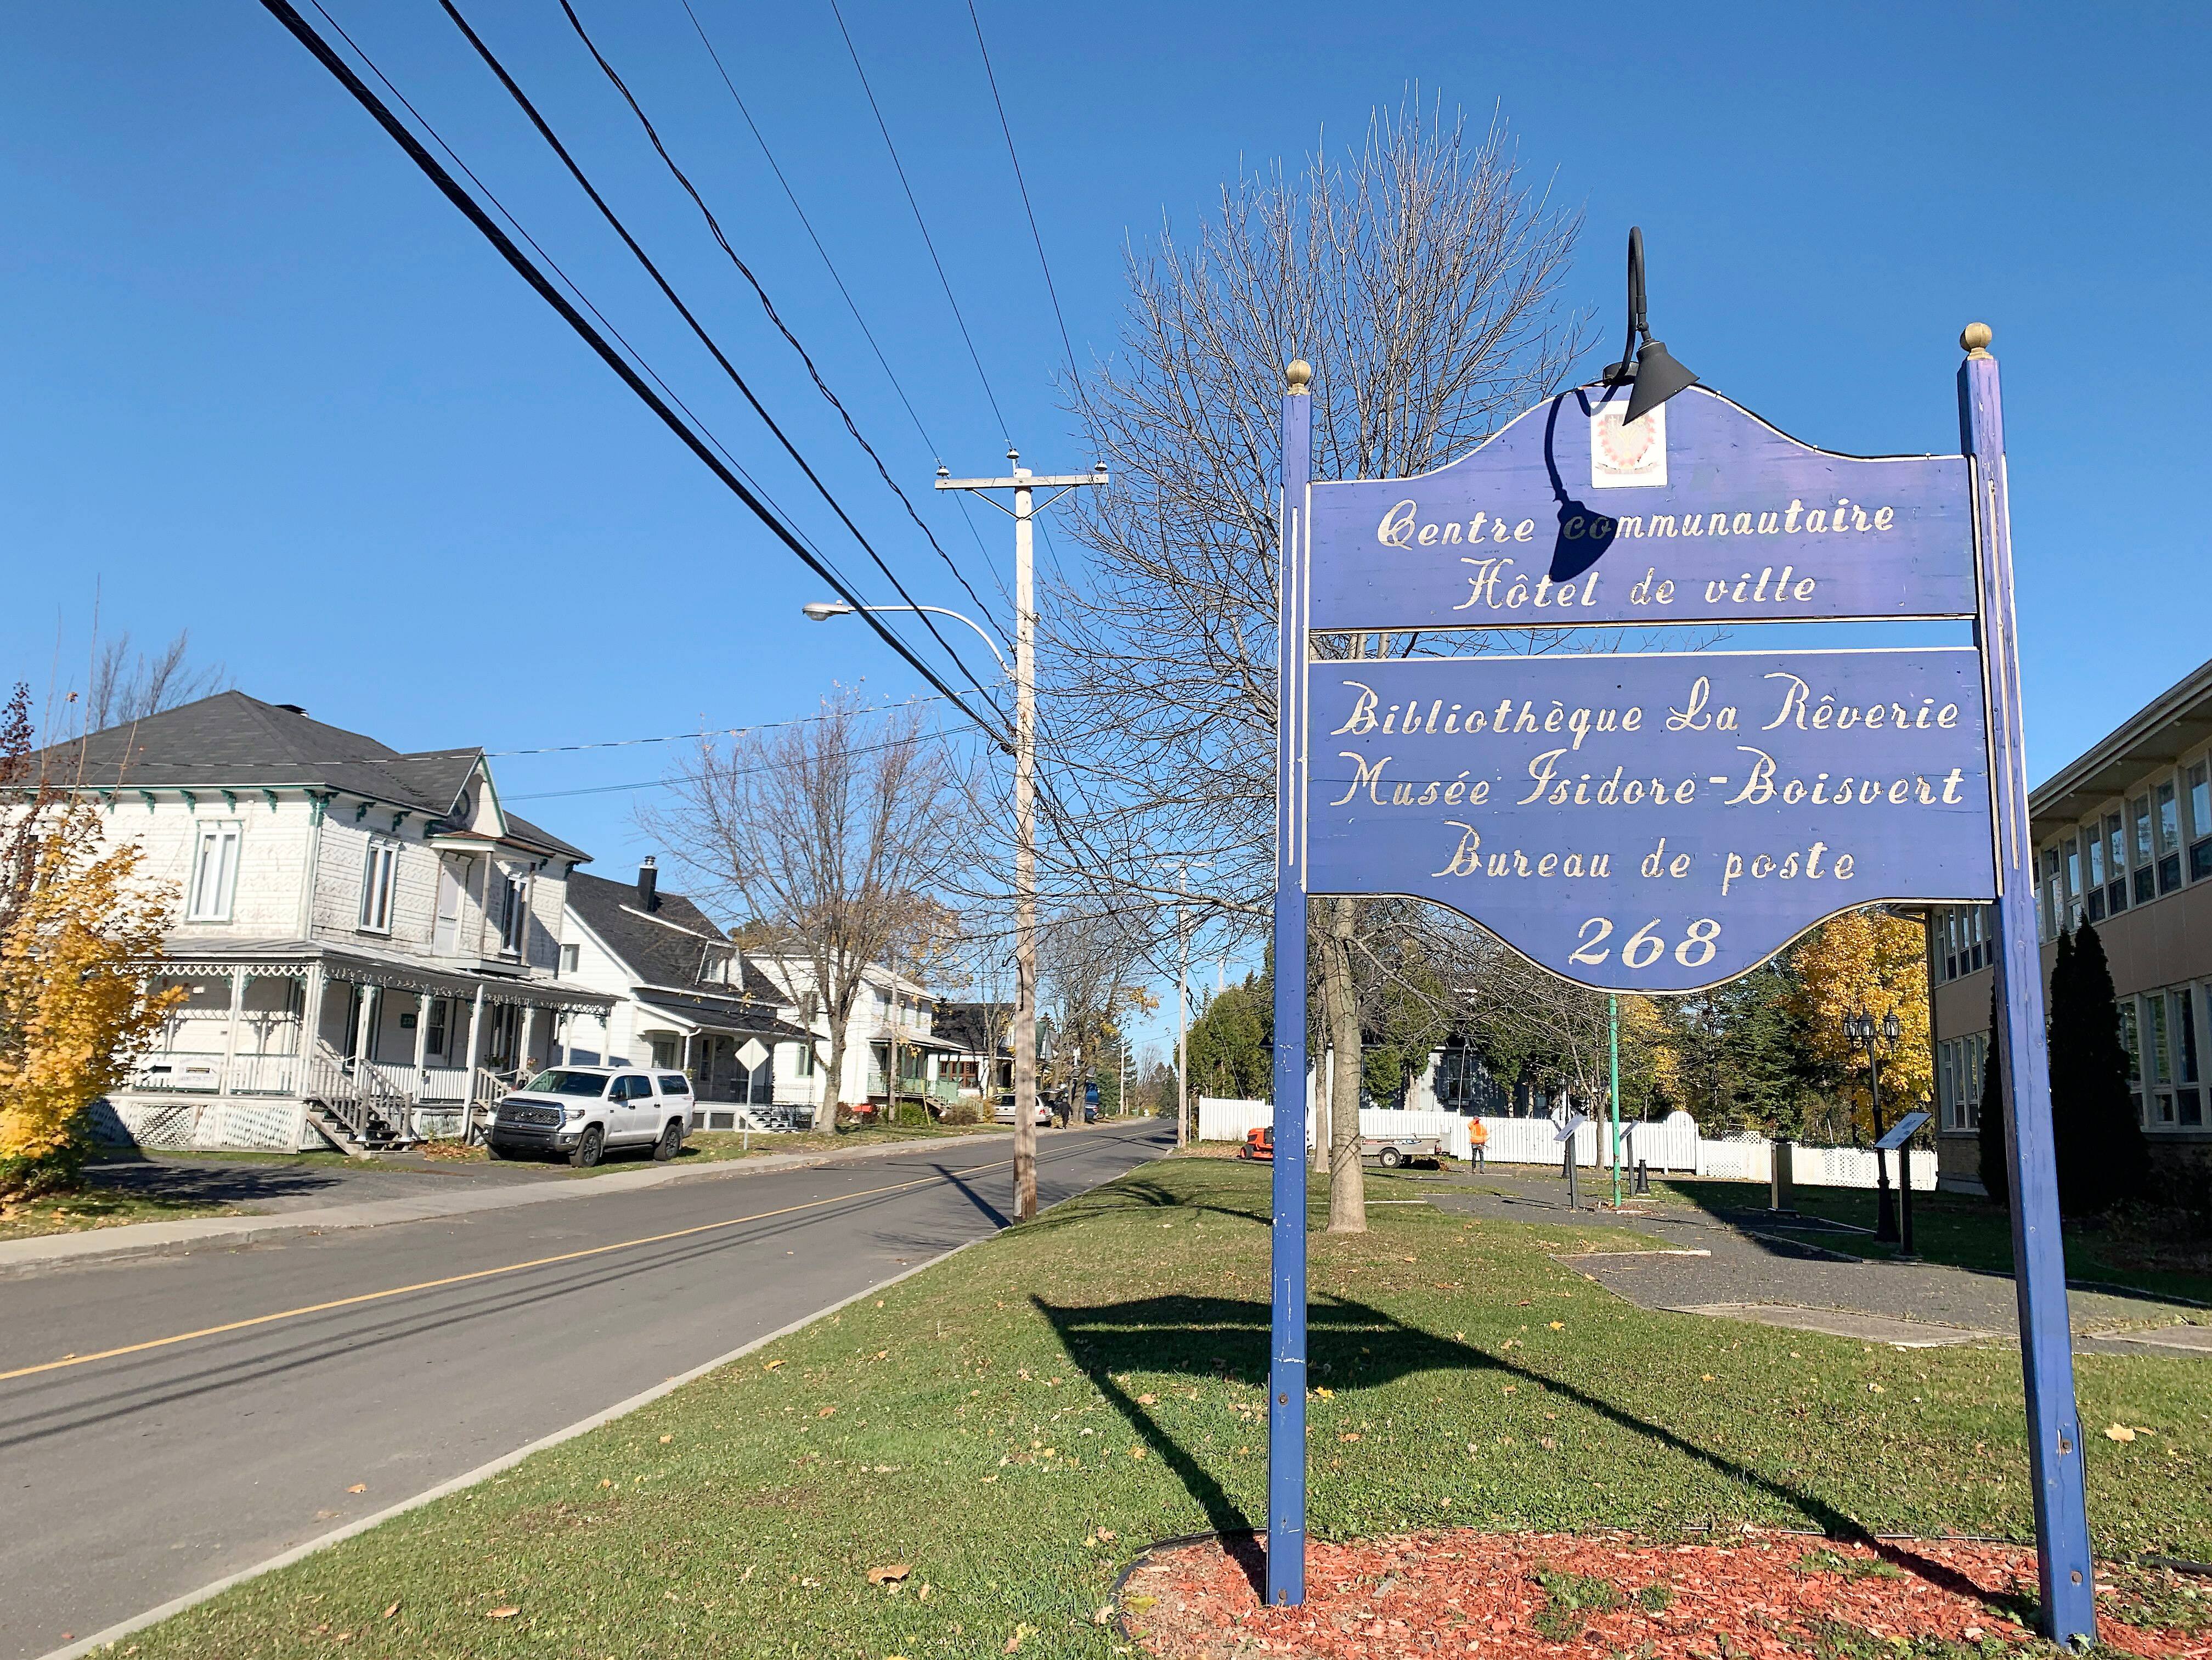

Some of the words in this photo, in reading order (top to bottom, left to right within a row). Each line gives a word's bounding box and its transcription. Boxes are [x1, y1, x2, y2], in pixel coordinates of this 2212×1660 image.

[1378, 499, 1534, 551] Centre
[1563, 499, 1894, 540] communautaire
[1453, 557, 1599, 610] Hôtel
[1630, 567, 1675, 605] de
[1705, 566, 1815, 603] ville
[1331, 681, 1641, 750] Bibliothèque
[1666, 676, 1738, 731] La
[1762, 672, 1957, 730] Rêverie
[1331, 751, 1489, 806] Musée
[1517, 746, 1963, 806] Isidore-Boisvert
[1432, 821, 1610, 878] Bureau
[1641, 838, 1689, 878] de
[1724, 842, 1855, 896] poste
[1569, 918, 1721, 969] 268
